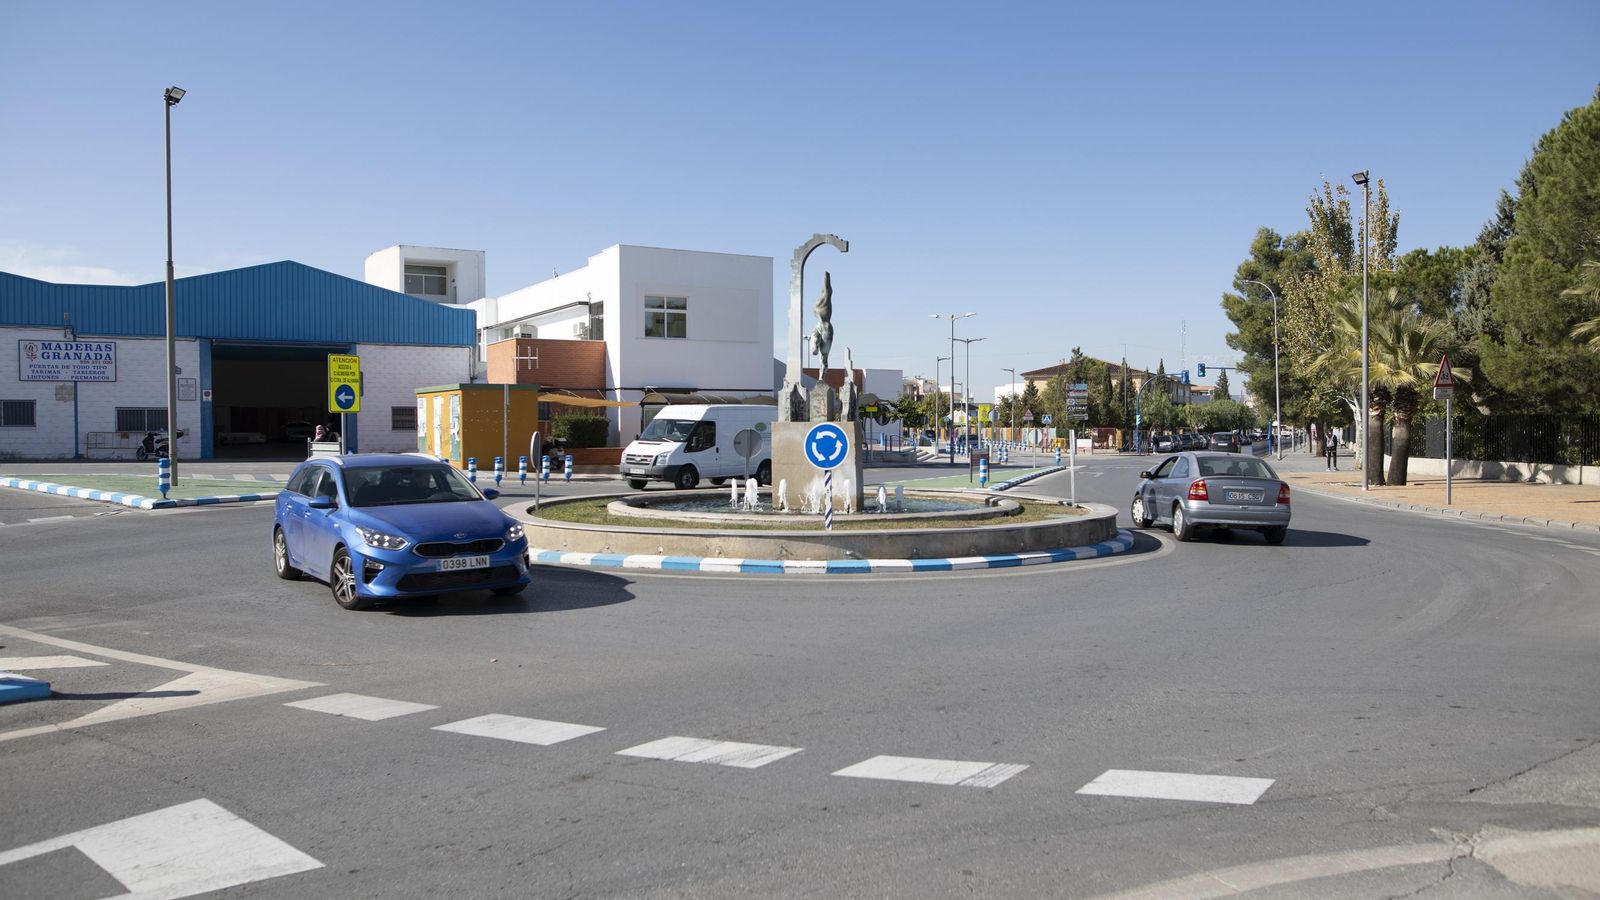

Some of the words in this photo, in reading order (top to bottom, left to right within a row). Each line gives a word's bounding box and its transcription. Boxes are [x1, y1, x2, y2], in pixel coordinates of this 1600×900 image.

[41, 343, 112, 352] MADERAS
[41, 352, 112, 360] GRANADA
[443, 559, 467, 570] 0398
[469, 557, 487, 568] LNN
